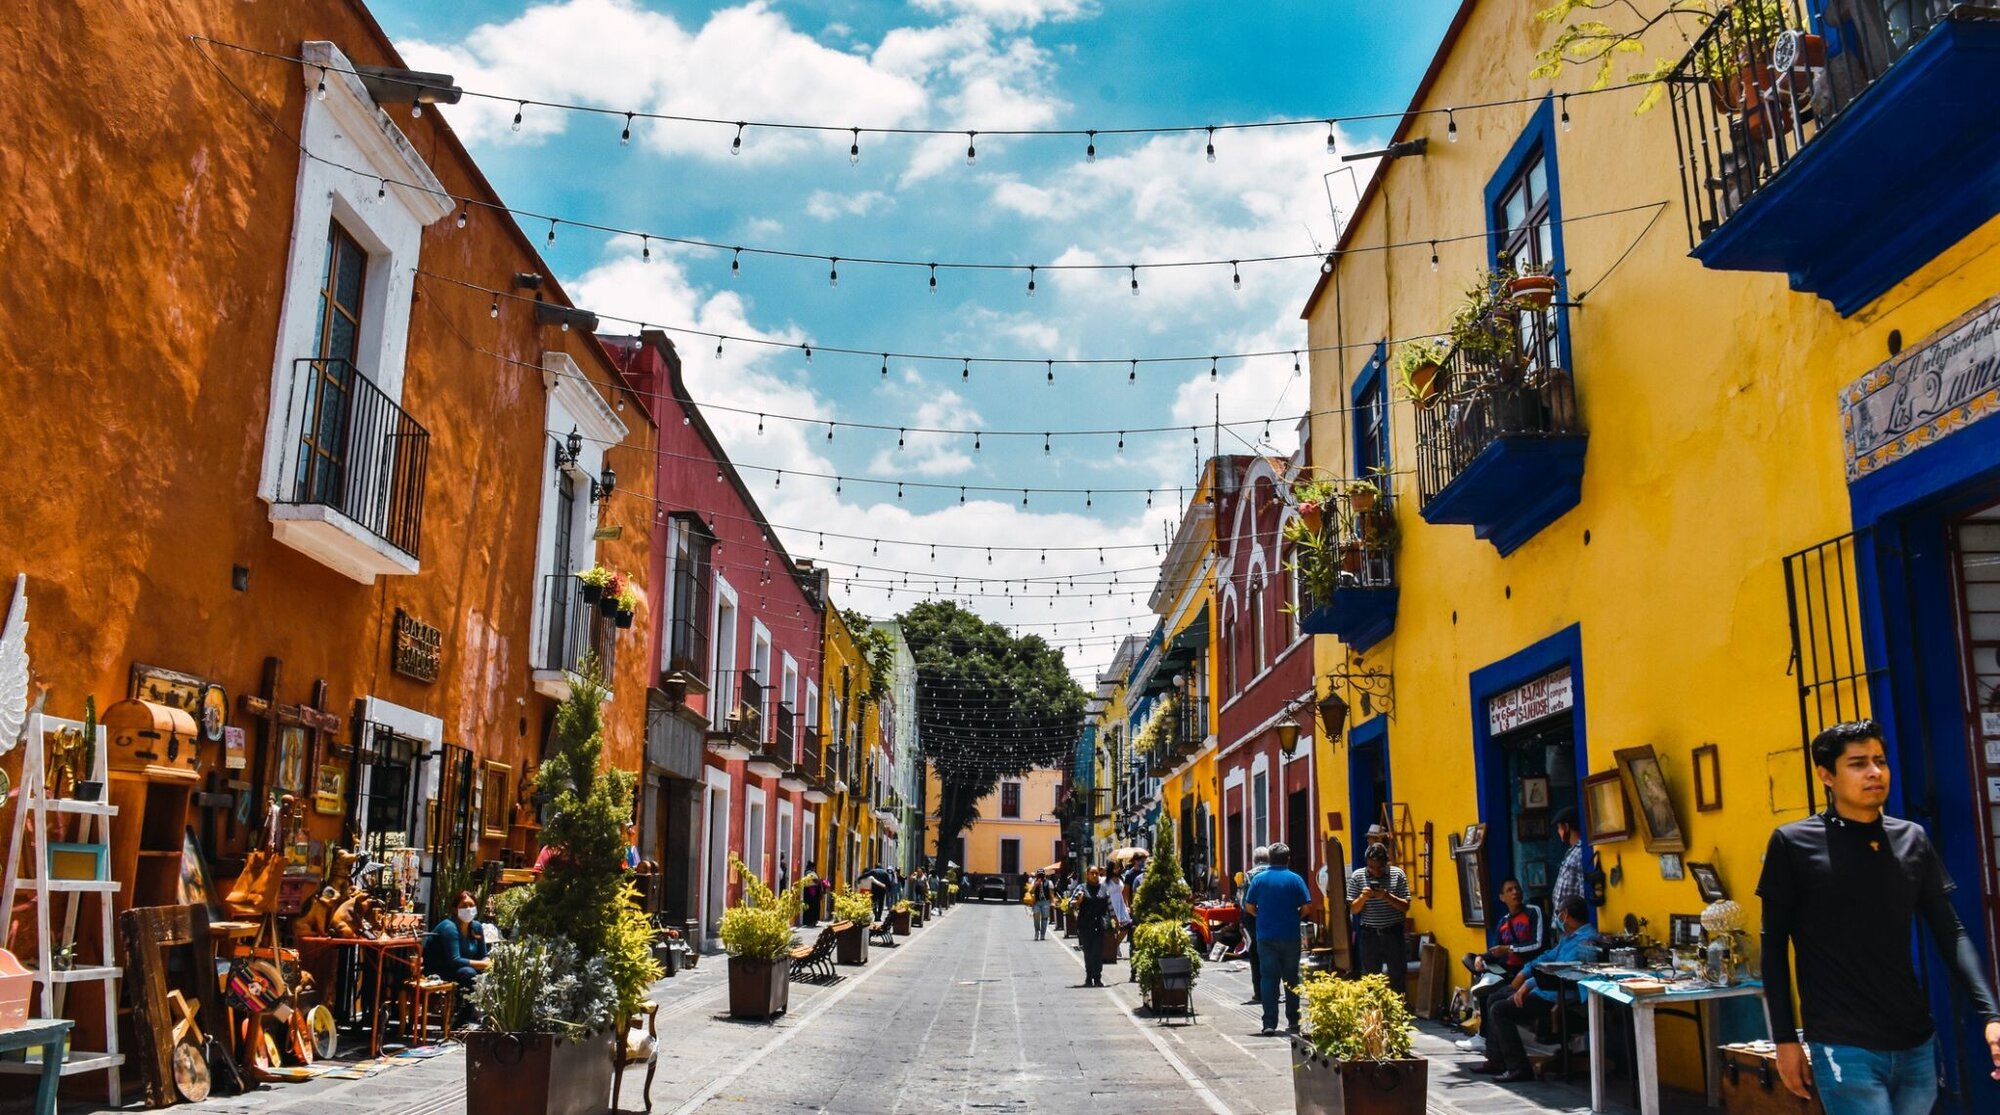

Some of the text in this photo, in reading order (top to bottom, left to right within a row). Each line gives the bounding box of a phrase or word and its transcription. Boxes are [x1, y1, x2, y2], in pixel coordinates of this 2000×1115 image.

[1884, 384, 1915, 434] Las
[404, 616, 438, 646] BAZAR
[1521, 679, 1547, 704] BAZAR
